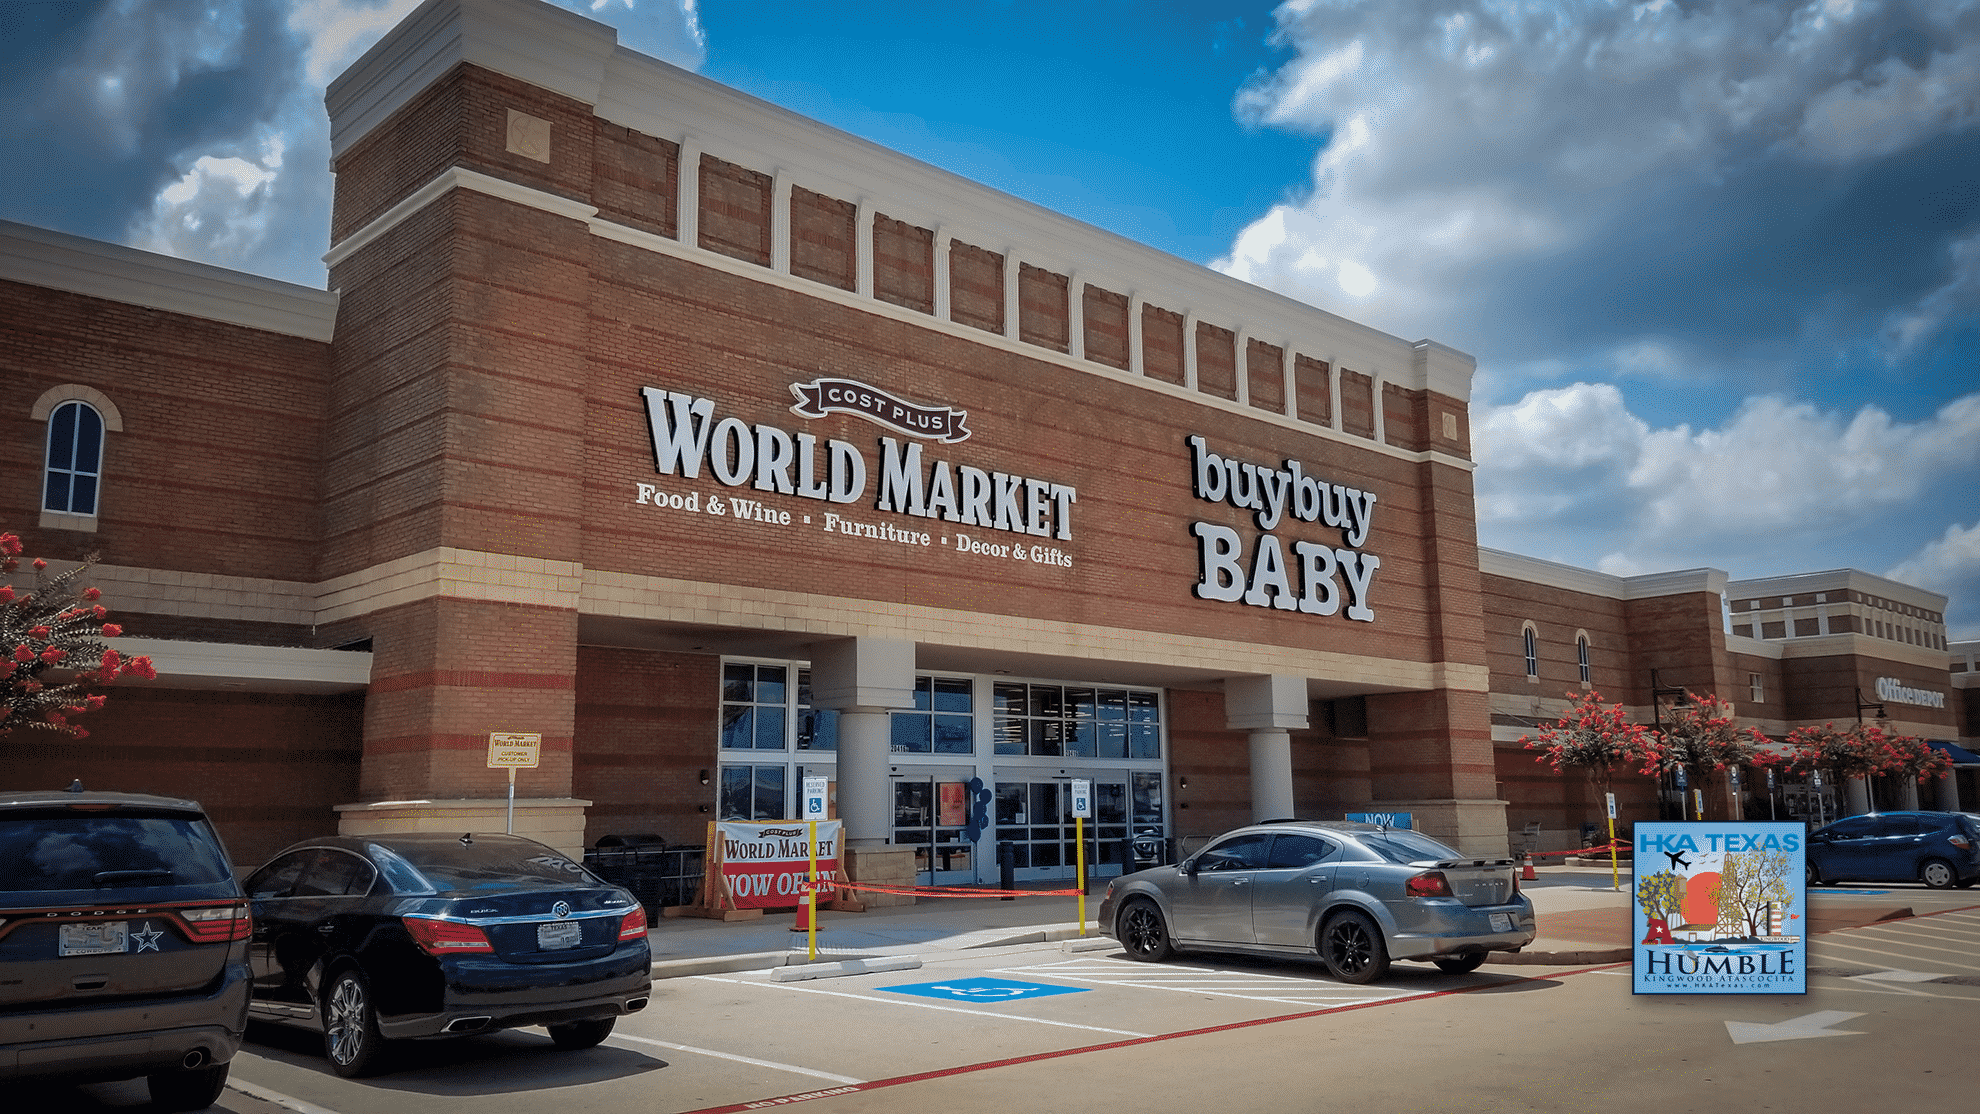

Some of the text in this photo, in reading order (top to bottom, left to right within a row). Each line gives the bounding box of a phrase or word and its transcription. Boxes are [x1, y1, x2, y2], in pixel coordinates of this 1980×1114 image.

[828, 388, 943, 429] COST PLUS
[642, 386, 1076, 541] WORLD MARKET
[1190, 435, 1377, 548] buybuy
[636, 482, 1073, 568] Food & Wine Furniture Decor & Gifts
[1194, 521, 1381, 622] BABY
[1913, 687, 1945, 709] DEPOT
[1365, 813, 1395, 827] NOW
[725, 839, 833, 859] WORLD MARET
[744, 1086, 860, 1109] NO PARKING
